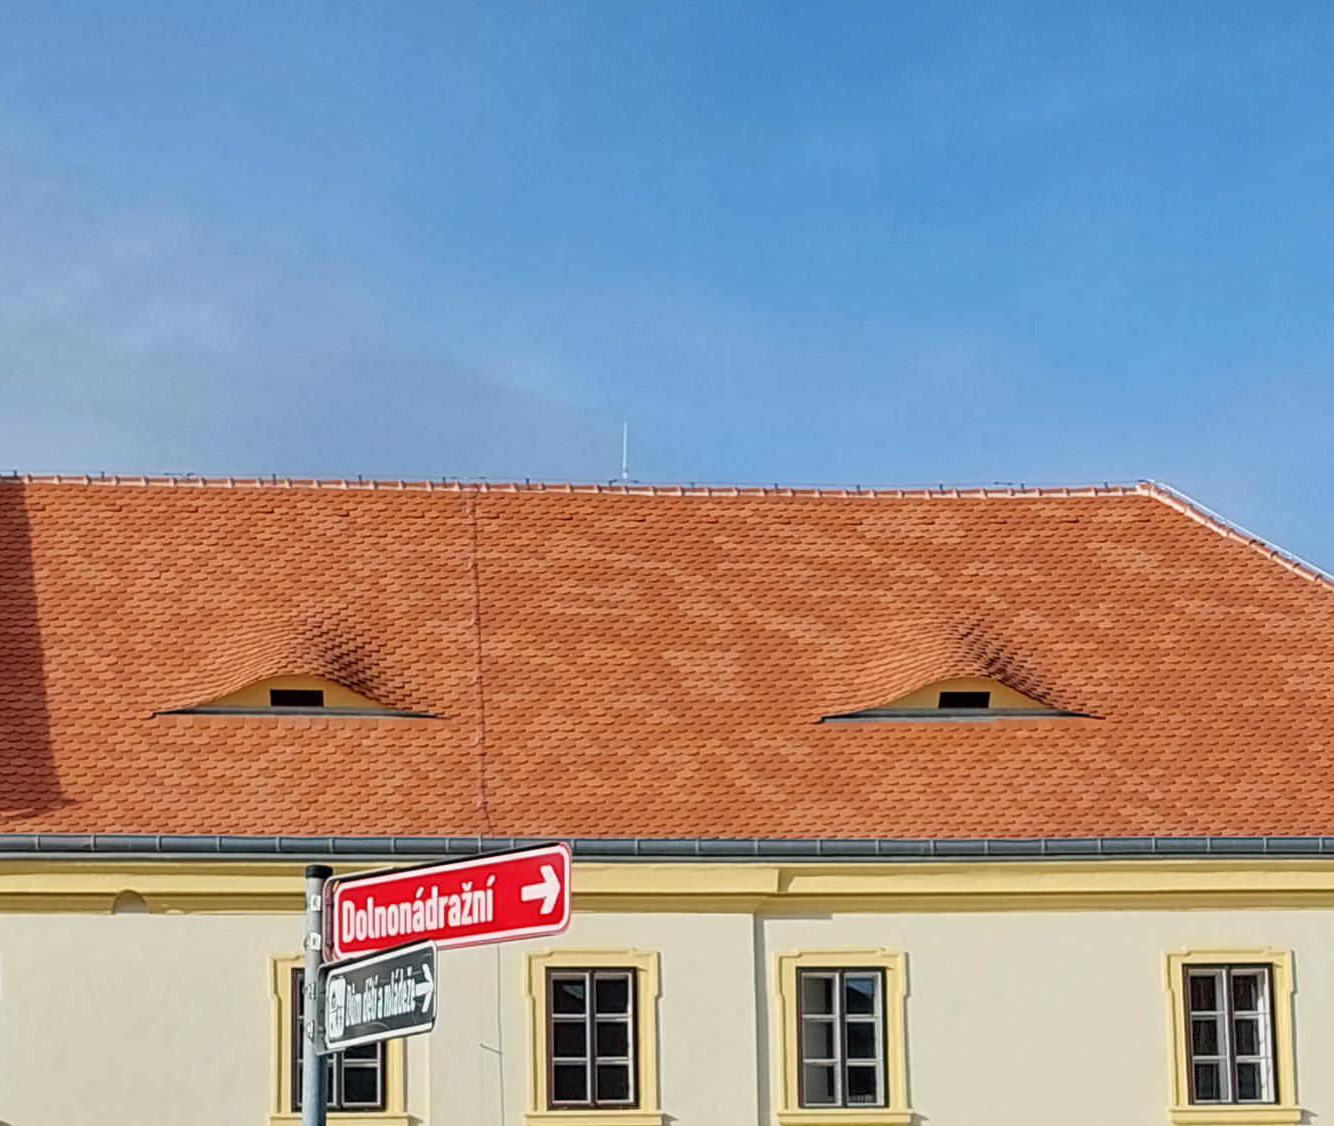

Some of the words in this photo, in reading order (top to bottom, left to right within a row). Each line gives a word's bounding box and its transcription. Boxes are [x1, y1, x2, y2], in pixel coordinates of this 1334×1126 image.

[342, 875, 496, 943] Dolnonádražní
[378, 986, 383, 1019] a
[384, 966, 416, 1017] mládeže
